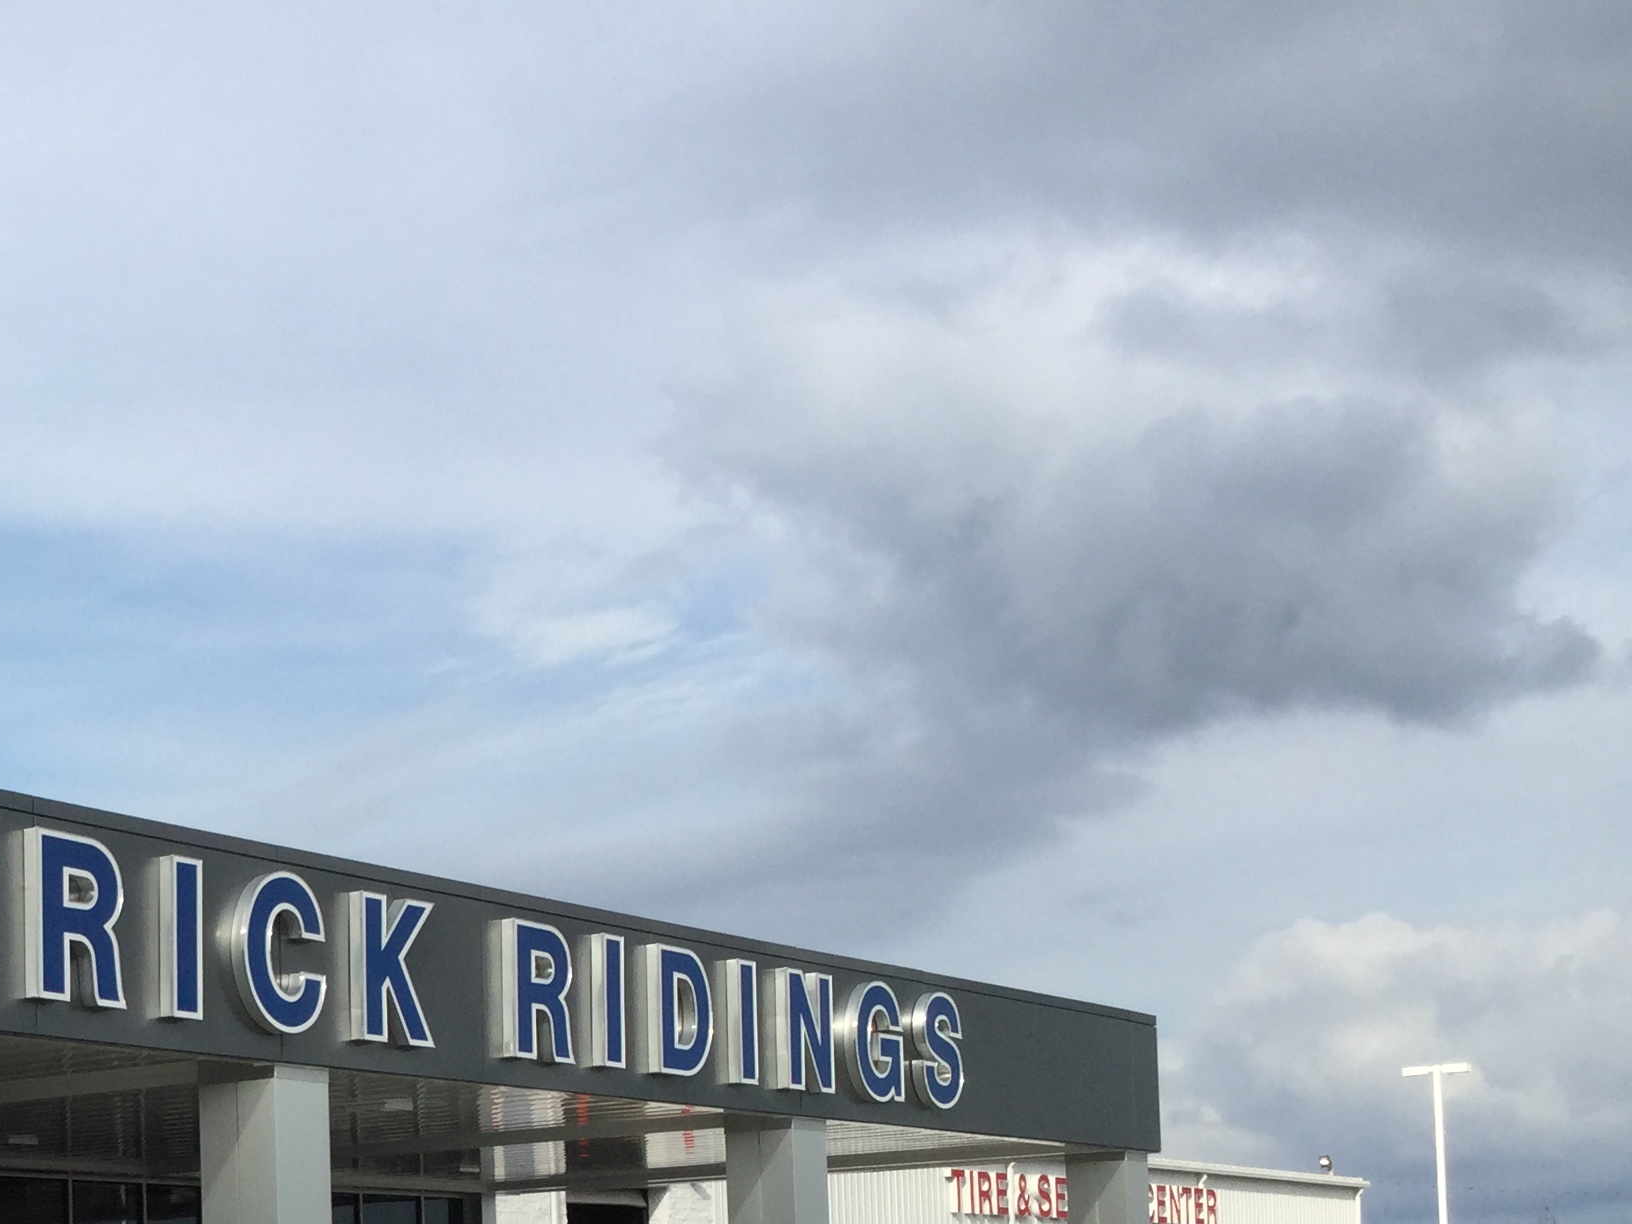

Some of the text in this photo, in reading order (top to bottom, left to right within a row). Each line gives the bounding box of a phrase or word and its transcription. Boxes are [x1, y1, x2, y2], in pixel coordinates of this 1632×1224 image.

[24, 826, 966, 1111] RICK RIDINGS
[950, 1168, 1009, 1216] TIRE
[1016, 1173, 1032, 1217] &
